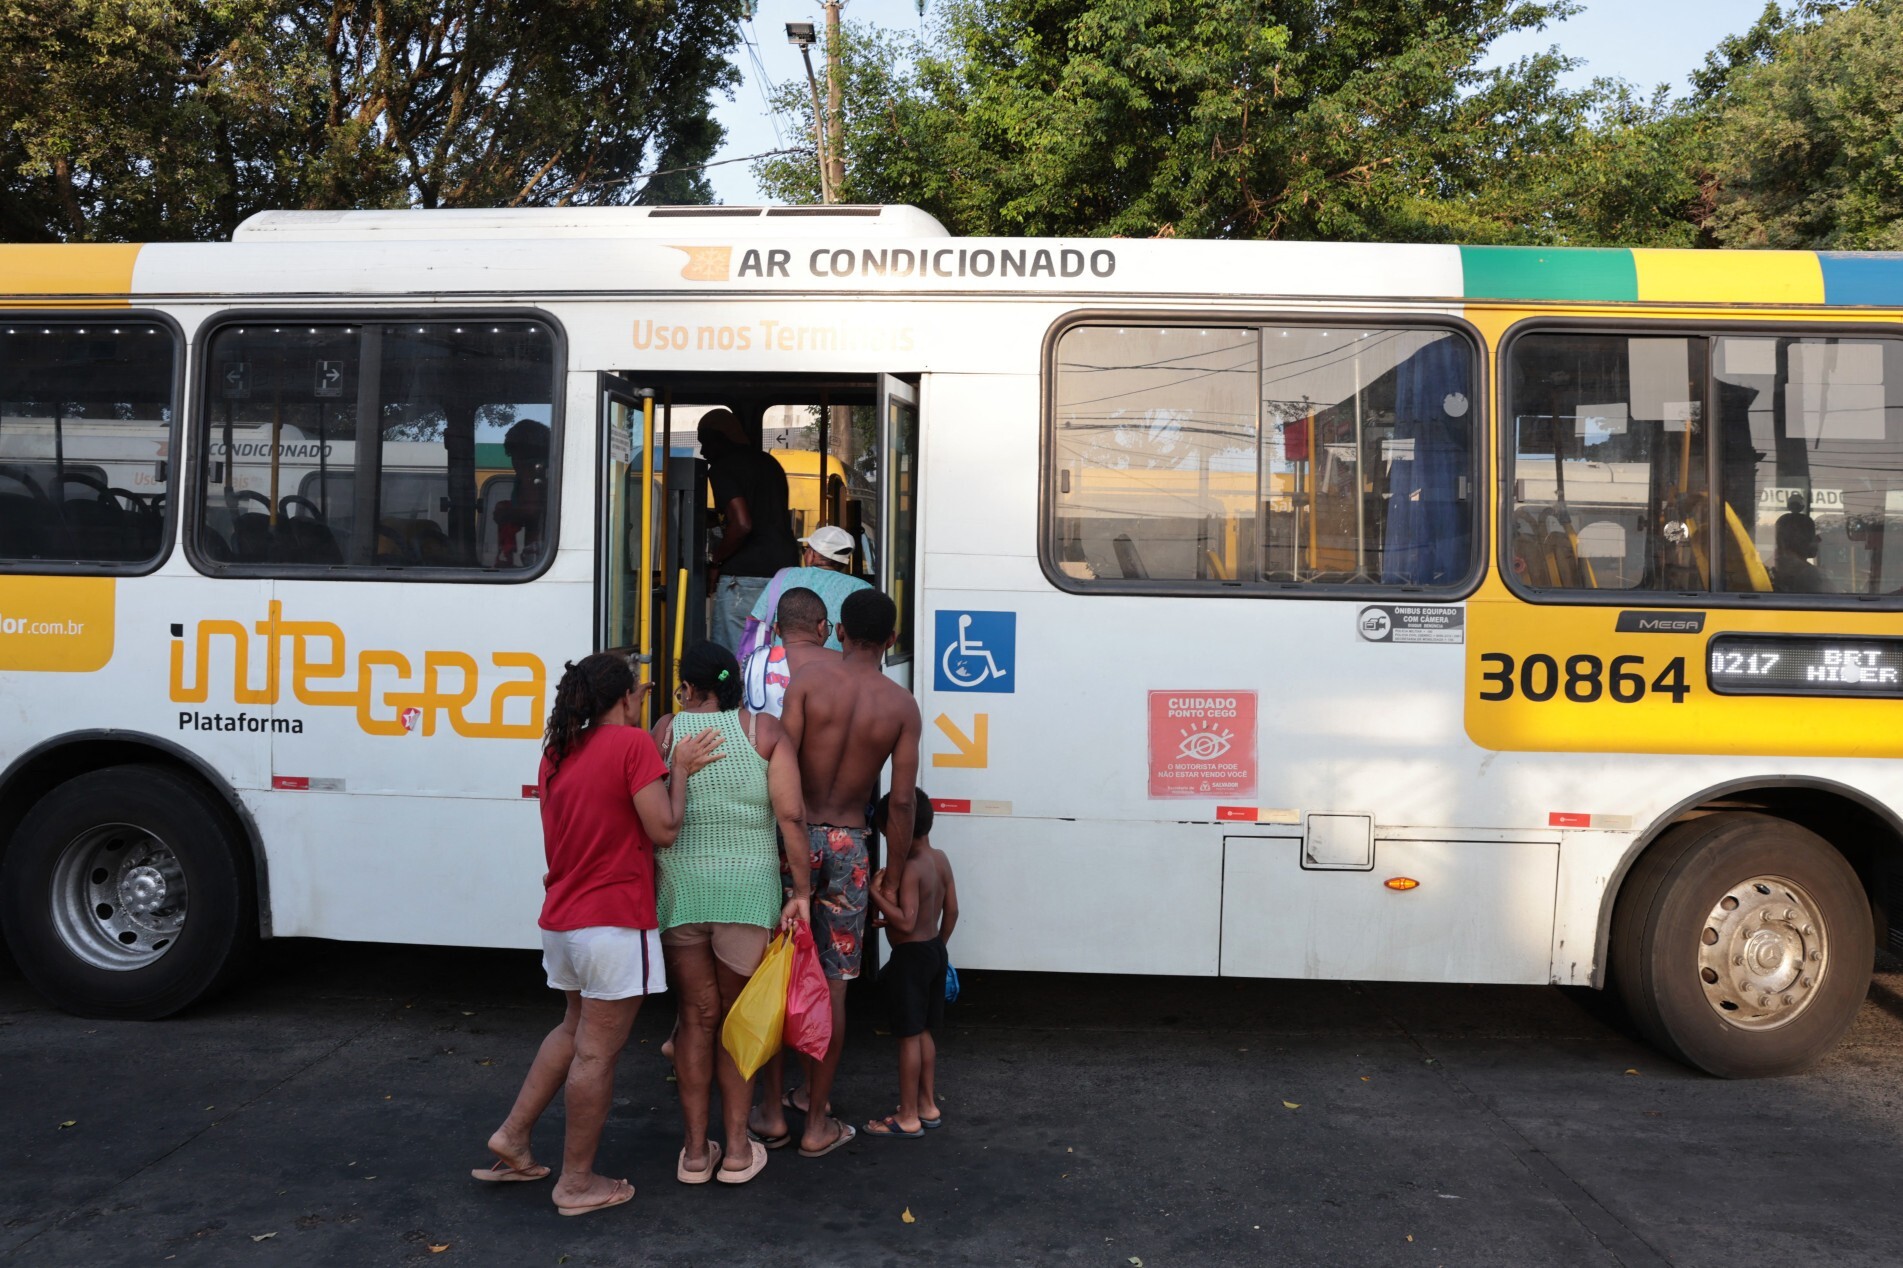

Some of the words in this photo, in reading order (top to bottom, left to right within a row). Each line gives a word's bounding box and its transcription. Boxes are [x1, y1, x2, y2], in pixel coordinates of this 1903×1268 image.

[737, 249, 791, 278] AR
[809, 248, 1116, 278] CONDICIONADO
[633, 320, 689, 350] Uso
[697, 326, 751, 350] nos
[759, 319, 914, 350] Termiis
[1394, 606, 1421, 615] ÔNIBUS
[1420, 615, 1449, 623] CÂMERA
[1639, 619, 1698, 629] MEGA
[1825, 650, 1882, 666] BRT
[1479, 652, 1691, 703] 30864
[1807, 666, 1898, 683] HIER
[1168, 698, 1237, 709] CUIDADO
[1168, 710, 1205, 718] PONTO
[1207, 710, 1237, 718] CEGO
[179, 711, 303, 734] Plataforma
[1158, 770, 1174, 778] NÃO
[1227, 770, 1248, 778] VOCÊ
